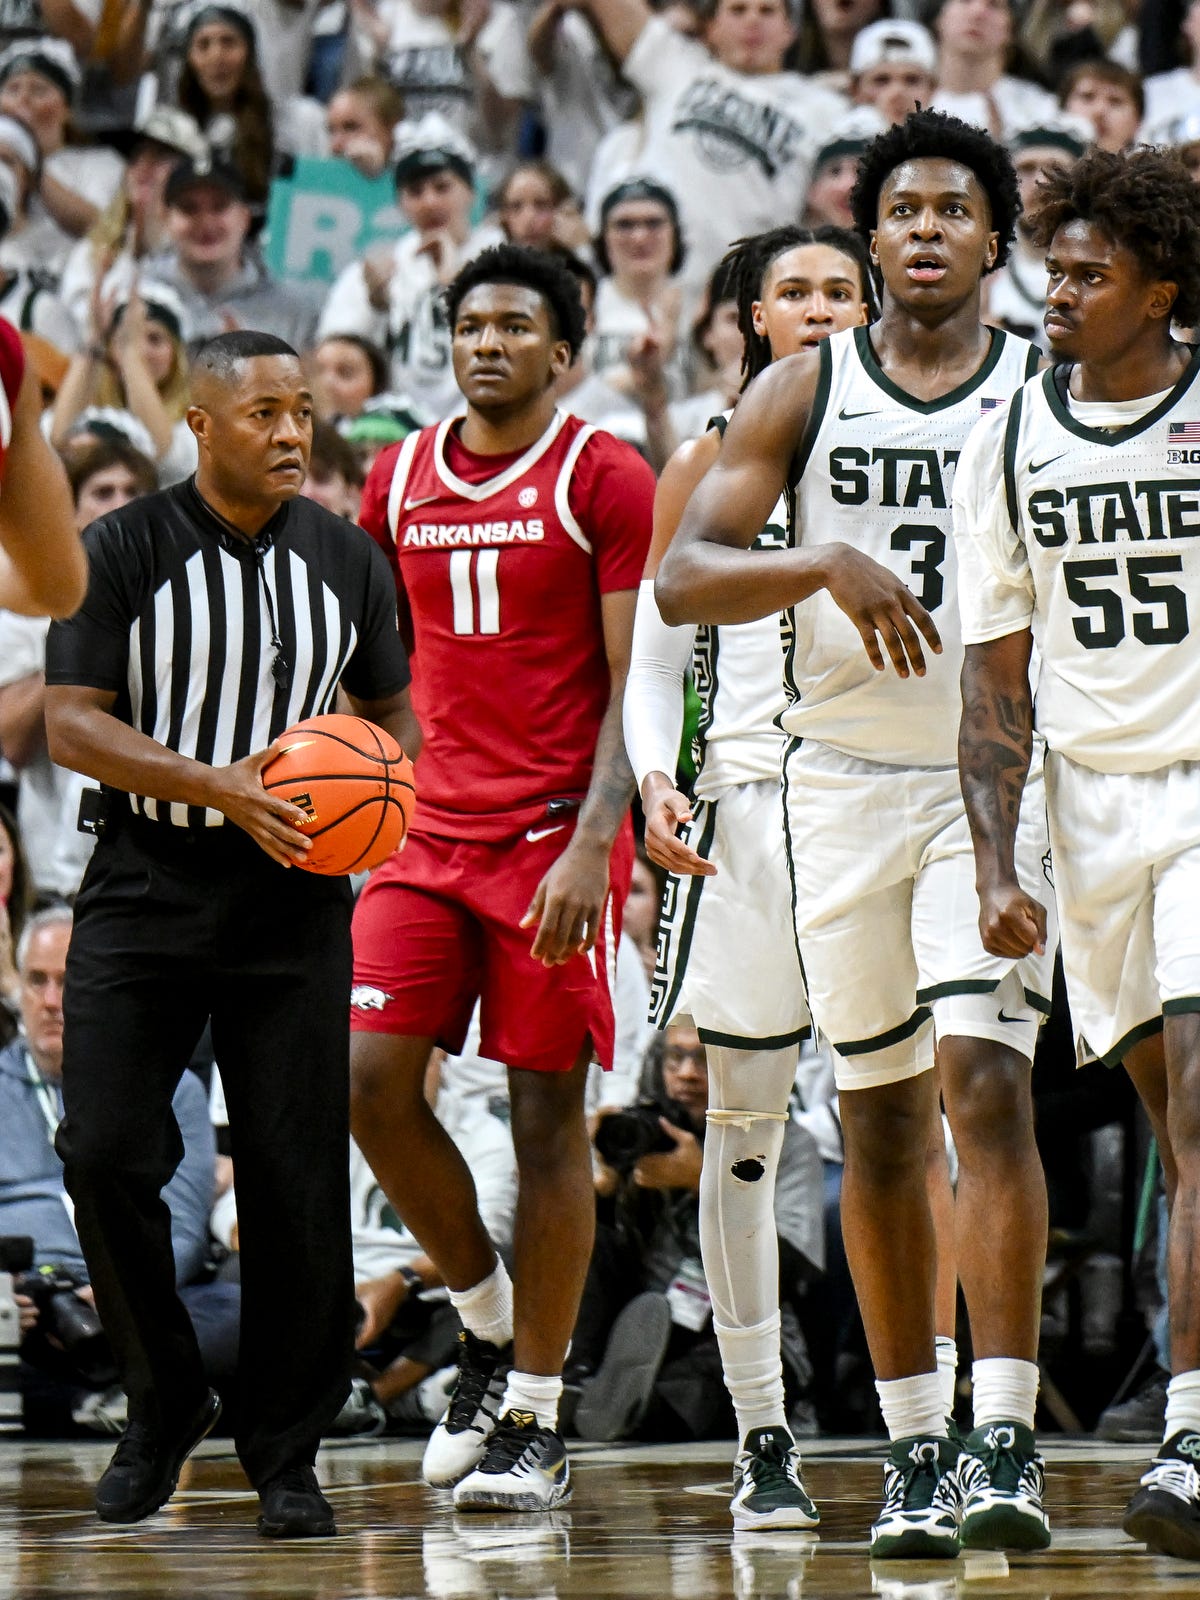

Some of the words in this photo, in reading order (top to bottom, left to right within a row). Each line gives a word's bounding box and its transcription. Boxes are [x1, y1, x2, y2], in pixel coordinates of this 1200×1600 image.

[829, 446, 961, 509] STA
[403, 519, 545, 547] ARKANSAS
[890, 523, 946, 613] 3
[449, 549, 501, 635] 11
[1063, 555, 1190, 649] 55
